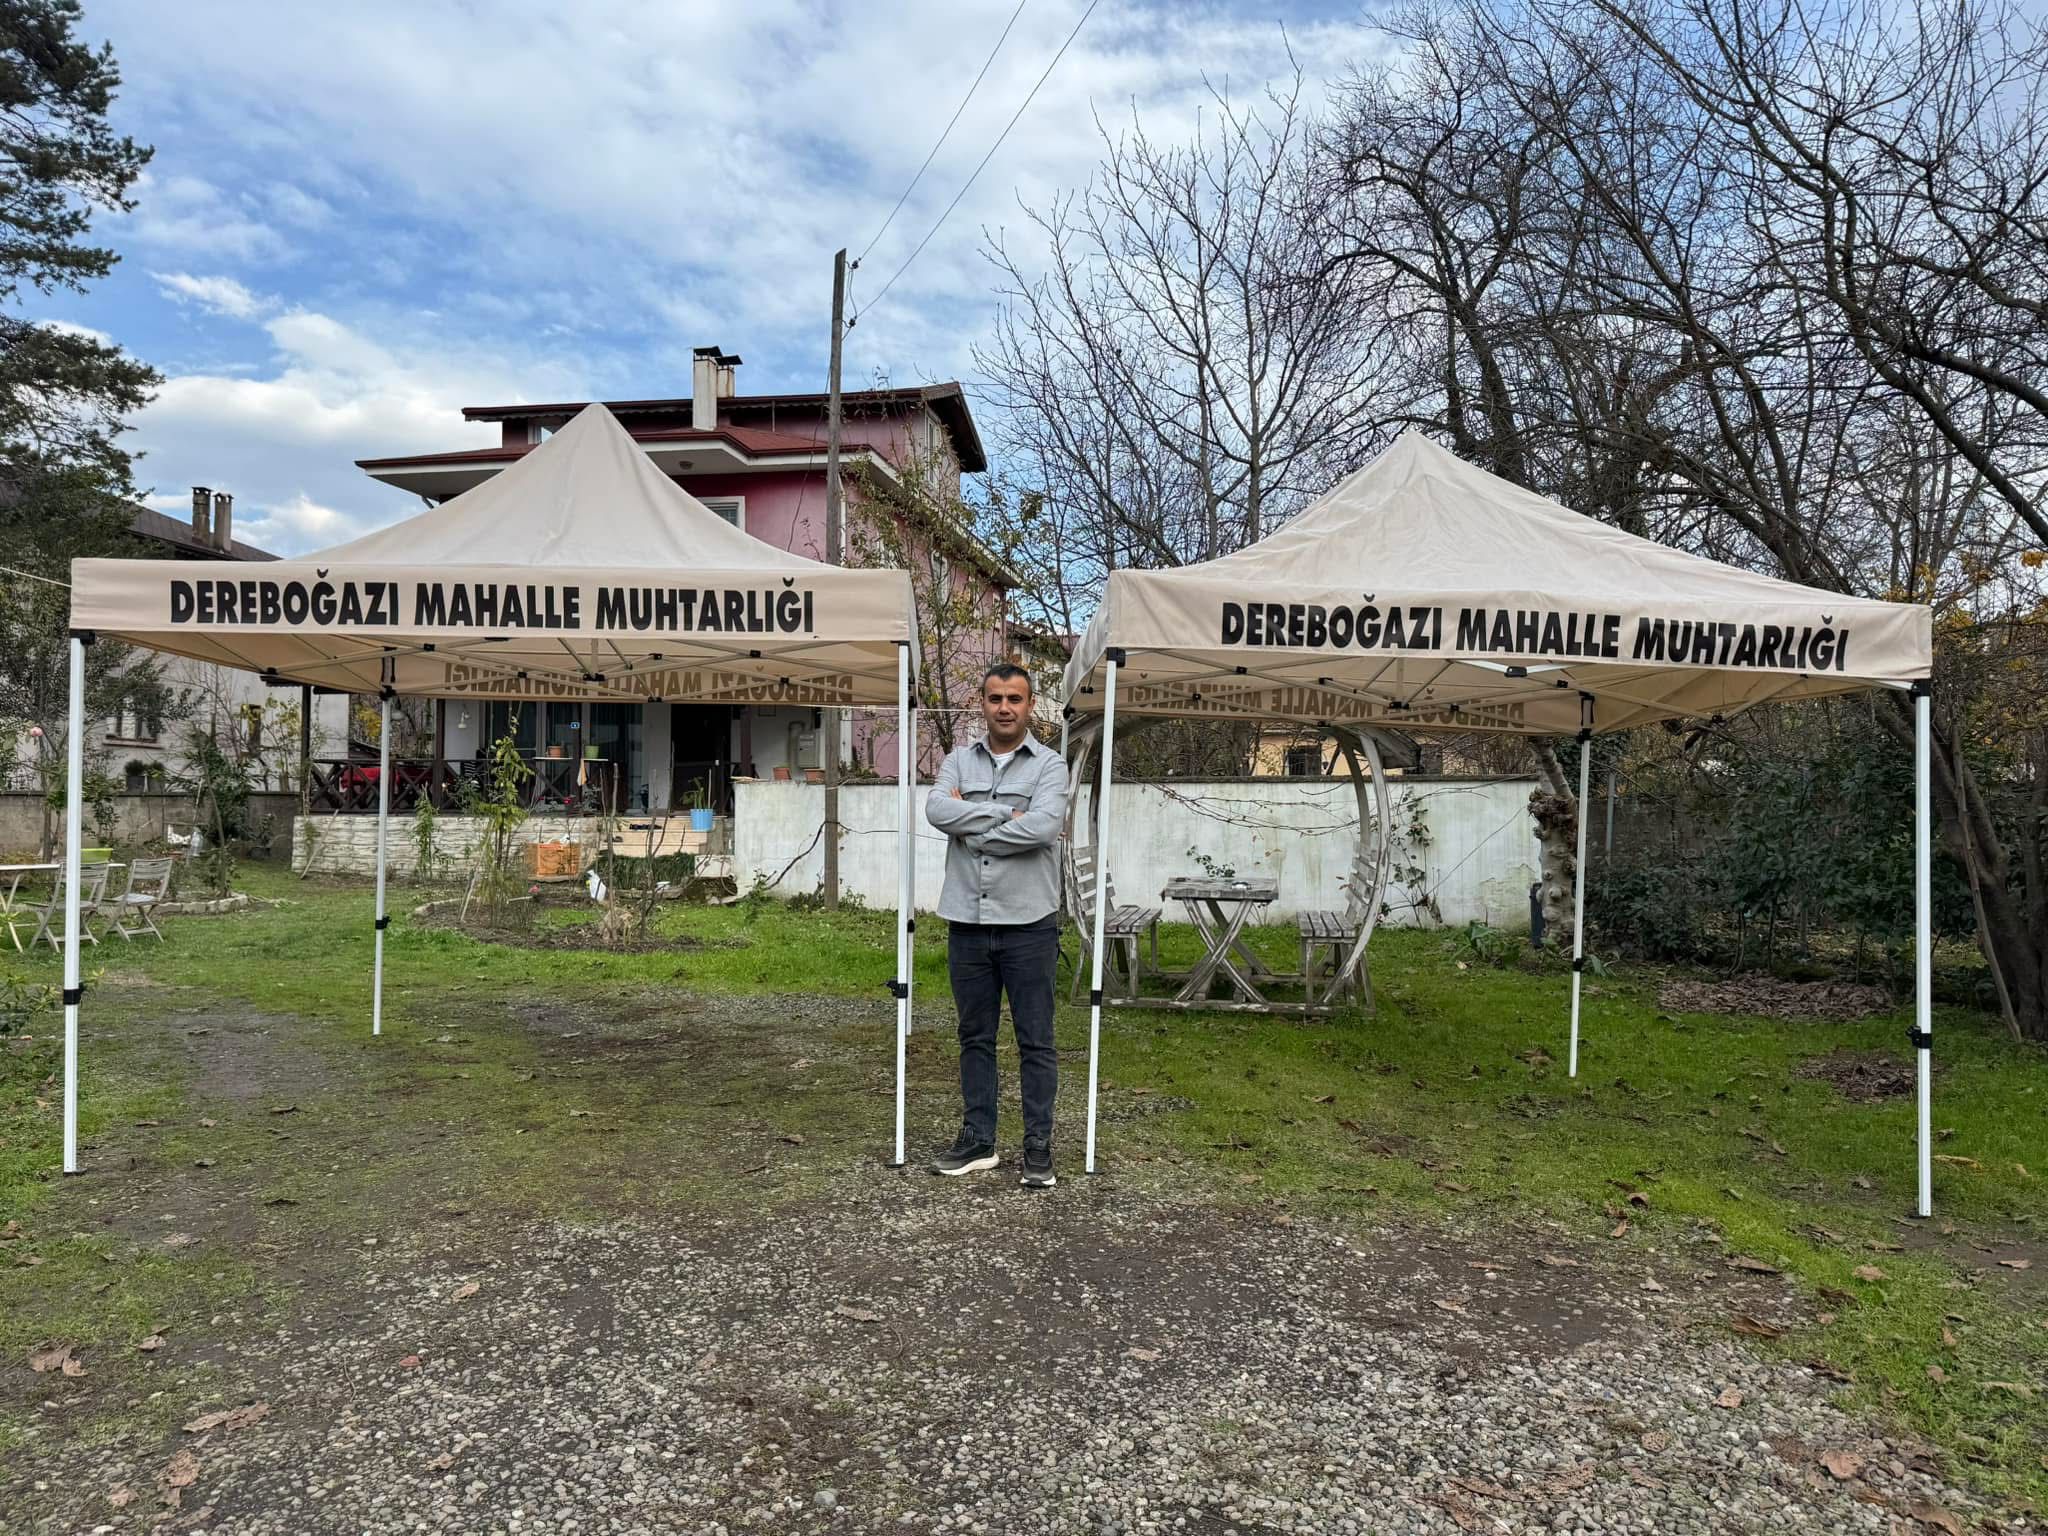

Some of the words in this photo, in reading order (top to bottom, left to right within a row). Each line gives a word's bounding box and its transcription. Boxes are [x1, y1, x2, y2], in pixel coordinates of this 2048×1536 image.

[171, 569, 399, 626] DEREBOĞAZI
[415, 583, 580, 630] MAHALLE
[595, 577, 813, 633] MUHTARLIĞI
[1221, 594, 1443, 651] DEREBOĞAZI
[1456, 608, 1620, 658] MAHALLE
[1632, 615, 1850, 671] MUHTARLIĞI
